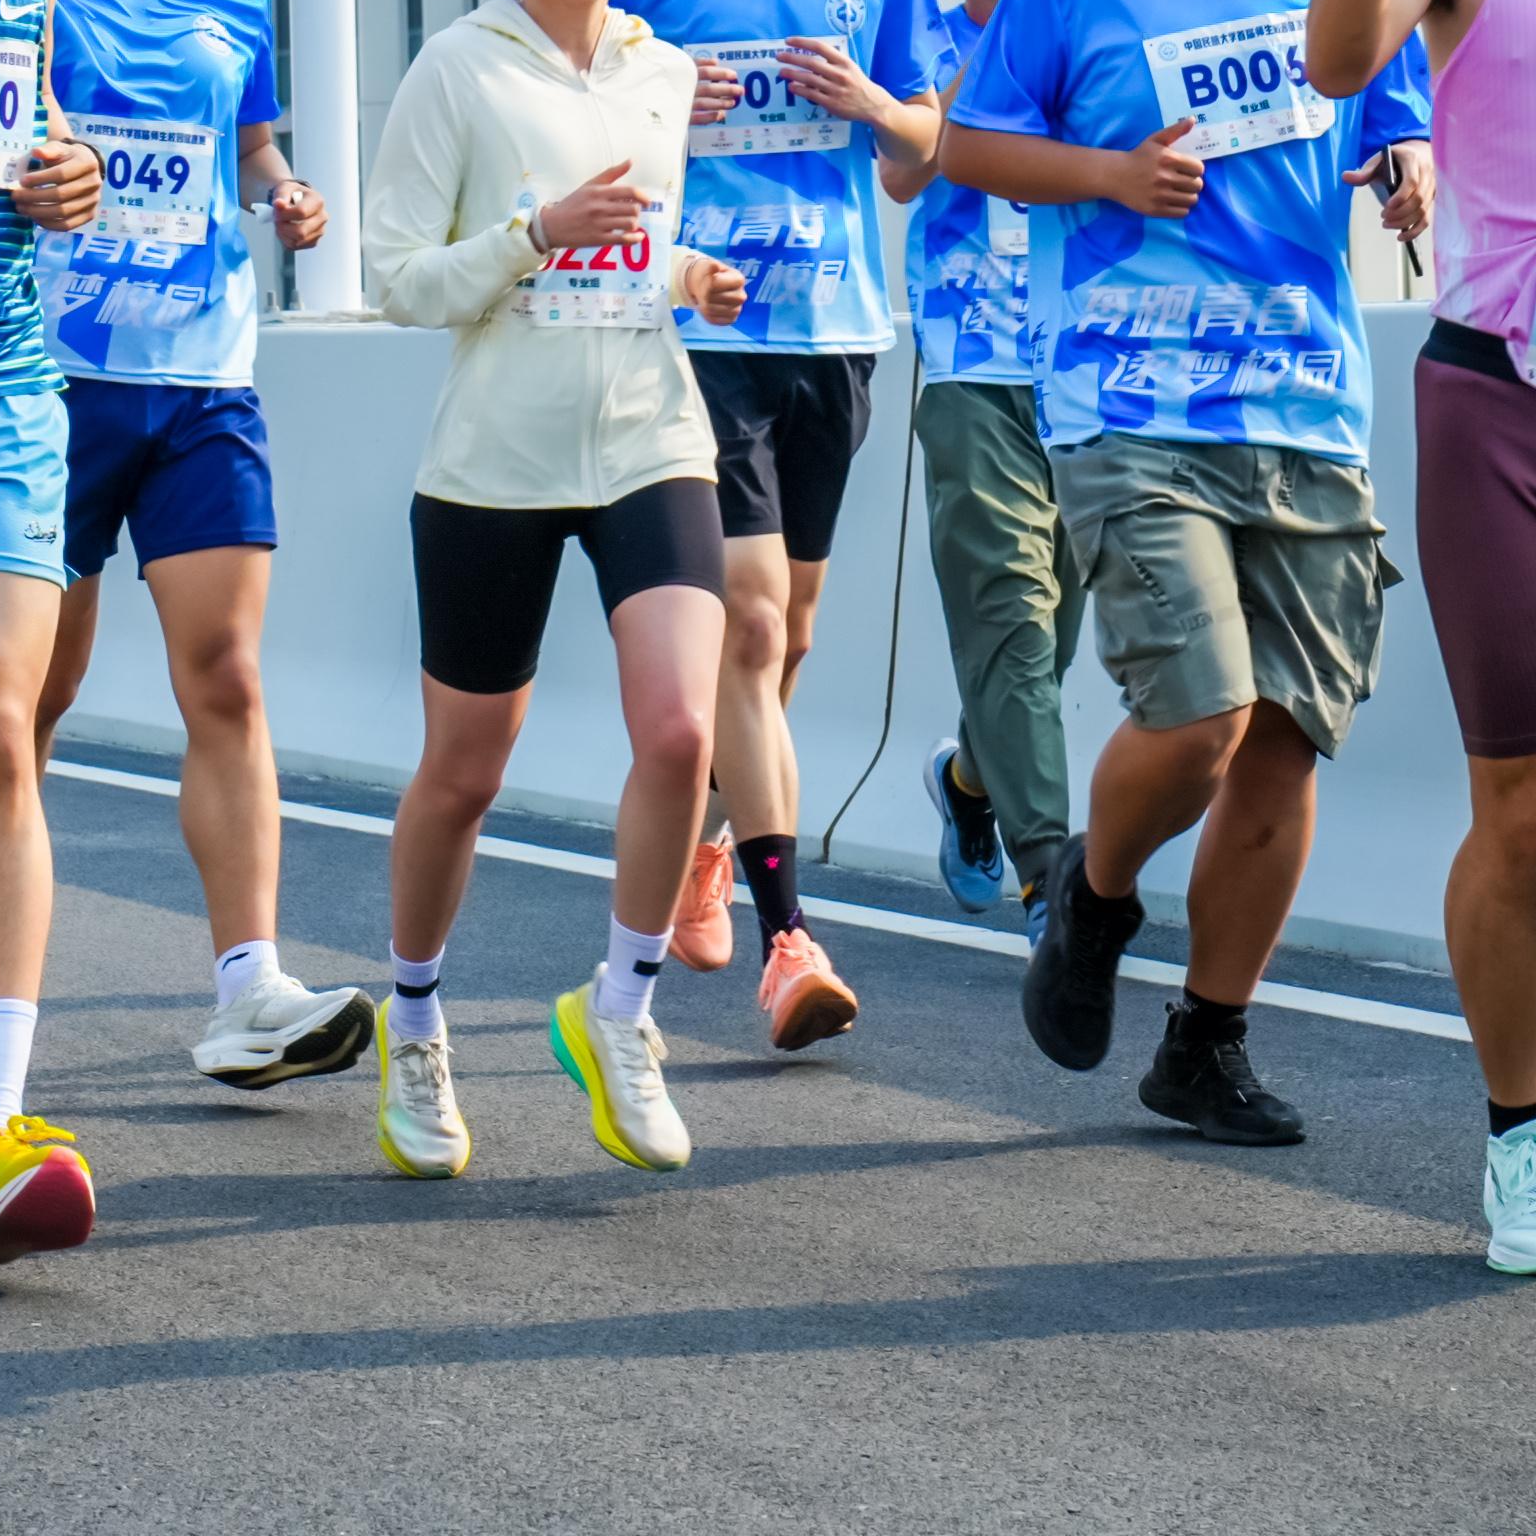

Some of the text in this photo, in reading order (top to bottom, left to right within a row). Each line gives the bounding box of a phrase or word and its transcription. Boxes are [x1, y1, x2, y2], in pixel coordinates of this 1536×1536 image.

[107, 149, 190, 194] 049
[1076, 283, 1312, 339] 奔跑青春
[1101, 348, 1344, 401] 逐梦校园
